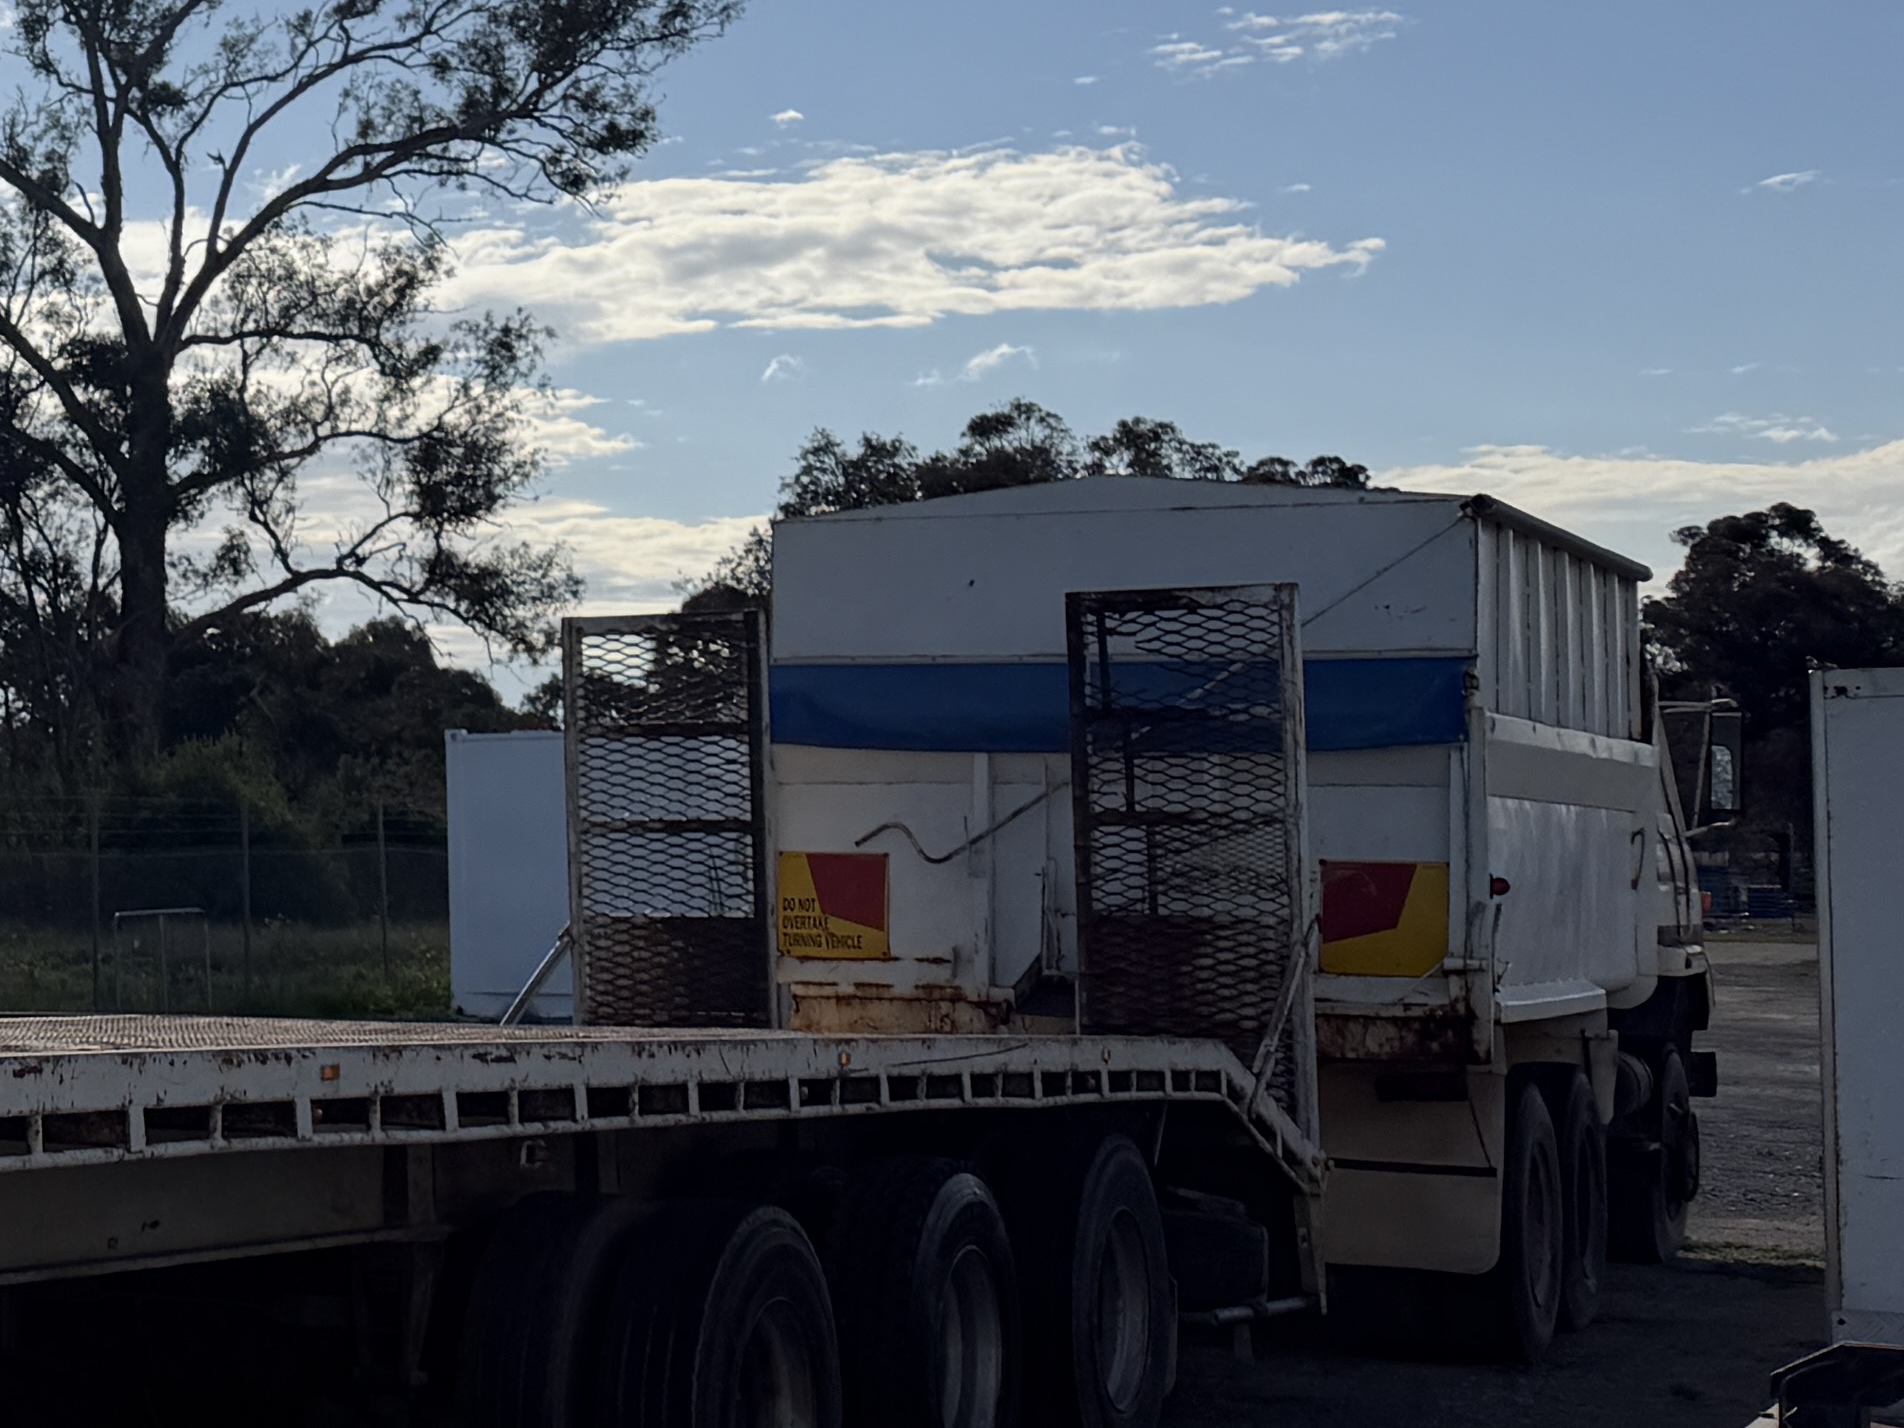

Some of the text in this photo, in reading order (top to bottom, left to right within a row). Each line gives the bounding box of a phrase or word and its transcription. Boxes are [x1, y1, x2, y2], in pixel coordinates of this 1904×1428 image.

[783, 897, 816, 912] DO NOT
[782, 915, 829, 930] OVERTAKE
[783, 932, 862, 950] TURNING VEHICLE
